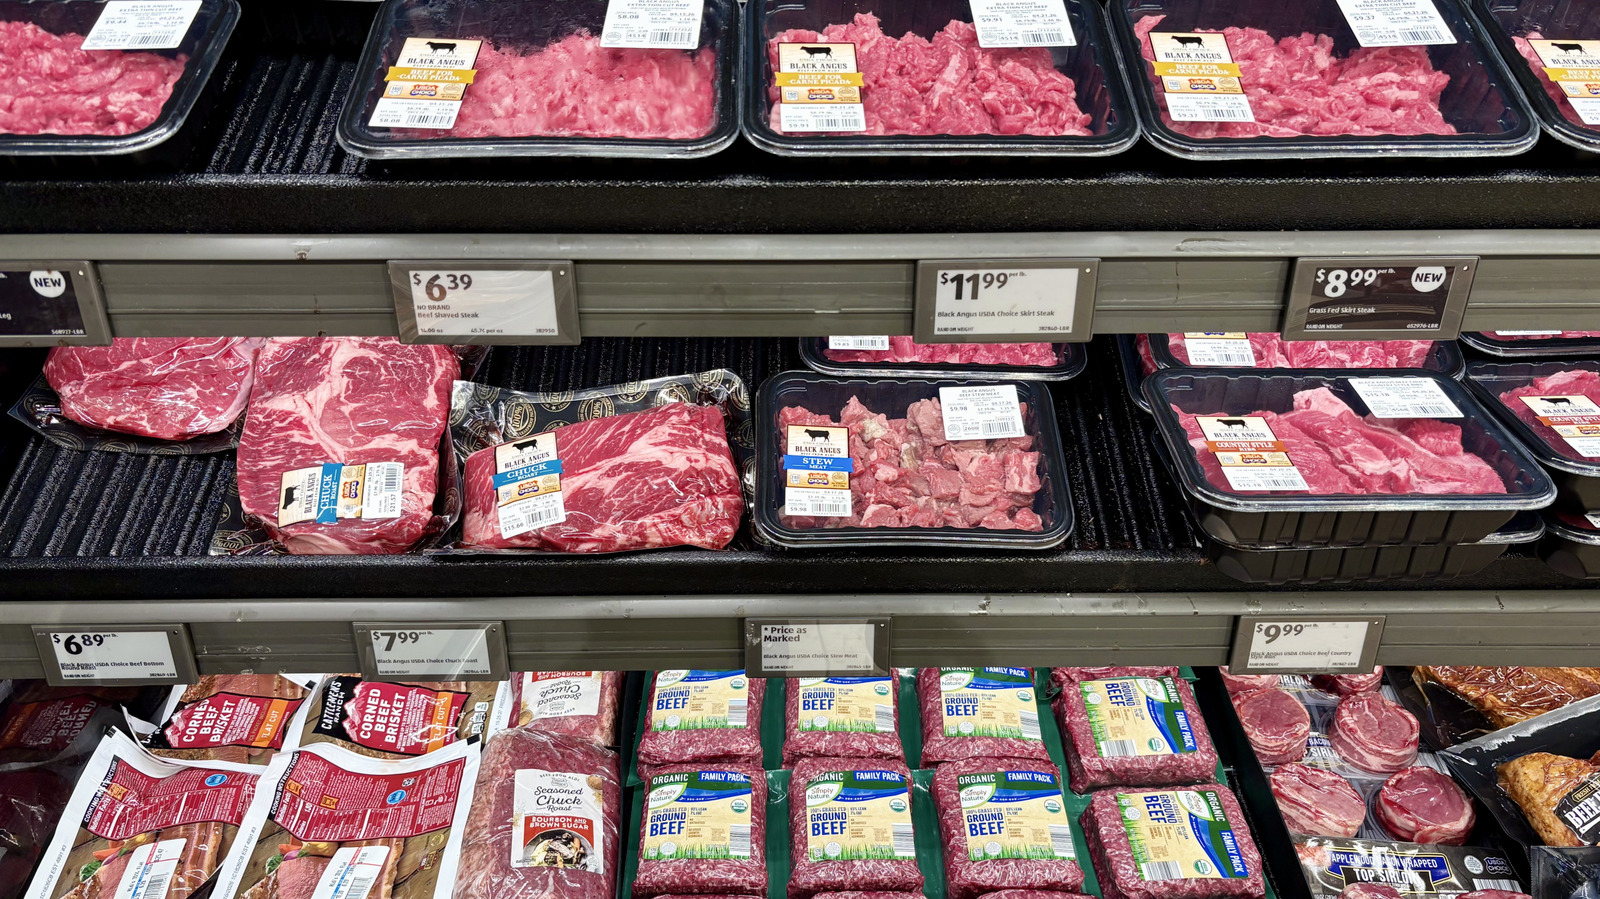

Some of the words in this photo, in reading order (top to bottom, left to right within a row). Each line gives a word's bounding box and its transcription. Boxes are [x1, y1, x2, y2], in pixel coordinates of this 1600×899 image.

[407, 57, 435, 65] BLACK
[437, 58, 466, 66] ANGUS
[1195, 52, 1222, 60] ANGUS
[34, 277, 62, 288] NEW
[1414, 273, 1443, 283] NEW
[956, 311, 977, 319] Angus
[819, 446, 841, 454] ANGUS
[505, 458, 527, 469] BLACK
[528, 451, 550, 463] ANGUS
[802, 457, 834, 465] STEW
[506, 462, 548, 479] CHUCK
[517, 471, 538, 481] ROAST
[320, 474, 333, 509] CHUCK
[330, 481, 338, 500] ROAST
[770, 626, 794, 634] Price
[763, 634, 801, 642] Marked
[984, 666, 1008, 674] FAMILY
[1008, 668, 1026, 677] PACK
[539, 684, 581, 698] Chuck
[657, 689, 690, 699] GROUND
[802, 691, 835, 699] GROUND
[1105, 683, 1127, 707] BEEF
[1120, 681, 1136, 707] GROUND
[1162, 676, 1180, 703] ORGANIC
[537, 693, 582, 708] Seasoned
[656, 697, 690, 710] BEEF
[802, 699, 835, 711] BEEF
[333, 692, 346, 724] RANCH
[360, 688, 381, 739] CORNED
[436, 703, 446, 721] CUT
[946, 704, 979, 716] BEEF
[182, 699, 211, 743] CORNED
[199, 706, 219, 735] BEEF
[209, 699, 236, 743] BRISKET
[374, 699, 391, 733] BEEF
[384, 692, 406, 744] BRISKET
[1174, 711, 1189, 731] FAMILY
[260, 722, 275, 739] FLAT
[269, 709, 280, 723] CUT
[432, 721, 443, 743] FLAT
[1181, 730, 1195, 748] PACK
[652, 773, 689, 785] ORGANIC
[701, 772, 727, 780] FAMILY
[727, 773, 745, 782] PACK
[856, 772, 881, 780] FAMILY
[882, 772, 900, 781] PACK
[958, 774, 996, 785] ORGANIC
[1007, 772, 1033, 781] FAMILY
[1033, 773, 1052, 783] PACK
[270, 786, 284, 815] COOKING
[279, 752, 300, 787] INSTRUCTIONS
[534, 785, 584, 796] Seasoned
[536, 794, 582, 806] Chuck
[1205, 791, 1226, 822] ORGANIC
[546, 804, 572, 812] Roast
[1143, 795, 1167, 824] BEEF
[1159, 794, 1178, 824] GROUND
[650, 811, 687, 823] GROUND
[810, 811, 847, 822] GROUND
[966, 812, 1004, 823] GROUND
[562, 822, 589, 830] SUGAR
[650, 821, 686, 837] BEEF
[811, 821, 847, 836] BEEF
[968, 821, 1005, 837] BEEF
[1221, 832, 1239, 856] FAMILY
[1230, 855, 1245, 873] PACK
[1353, 869, 1375, 881] TOP
